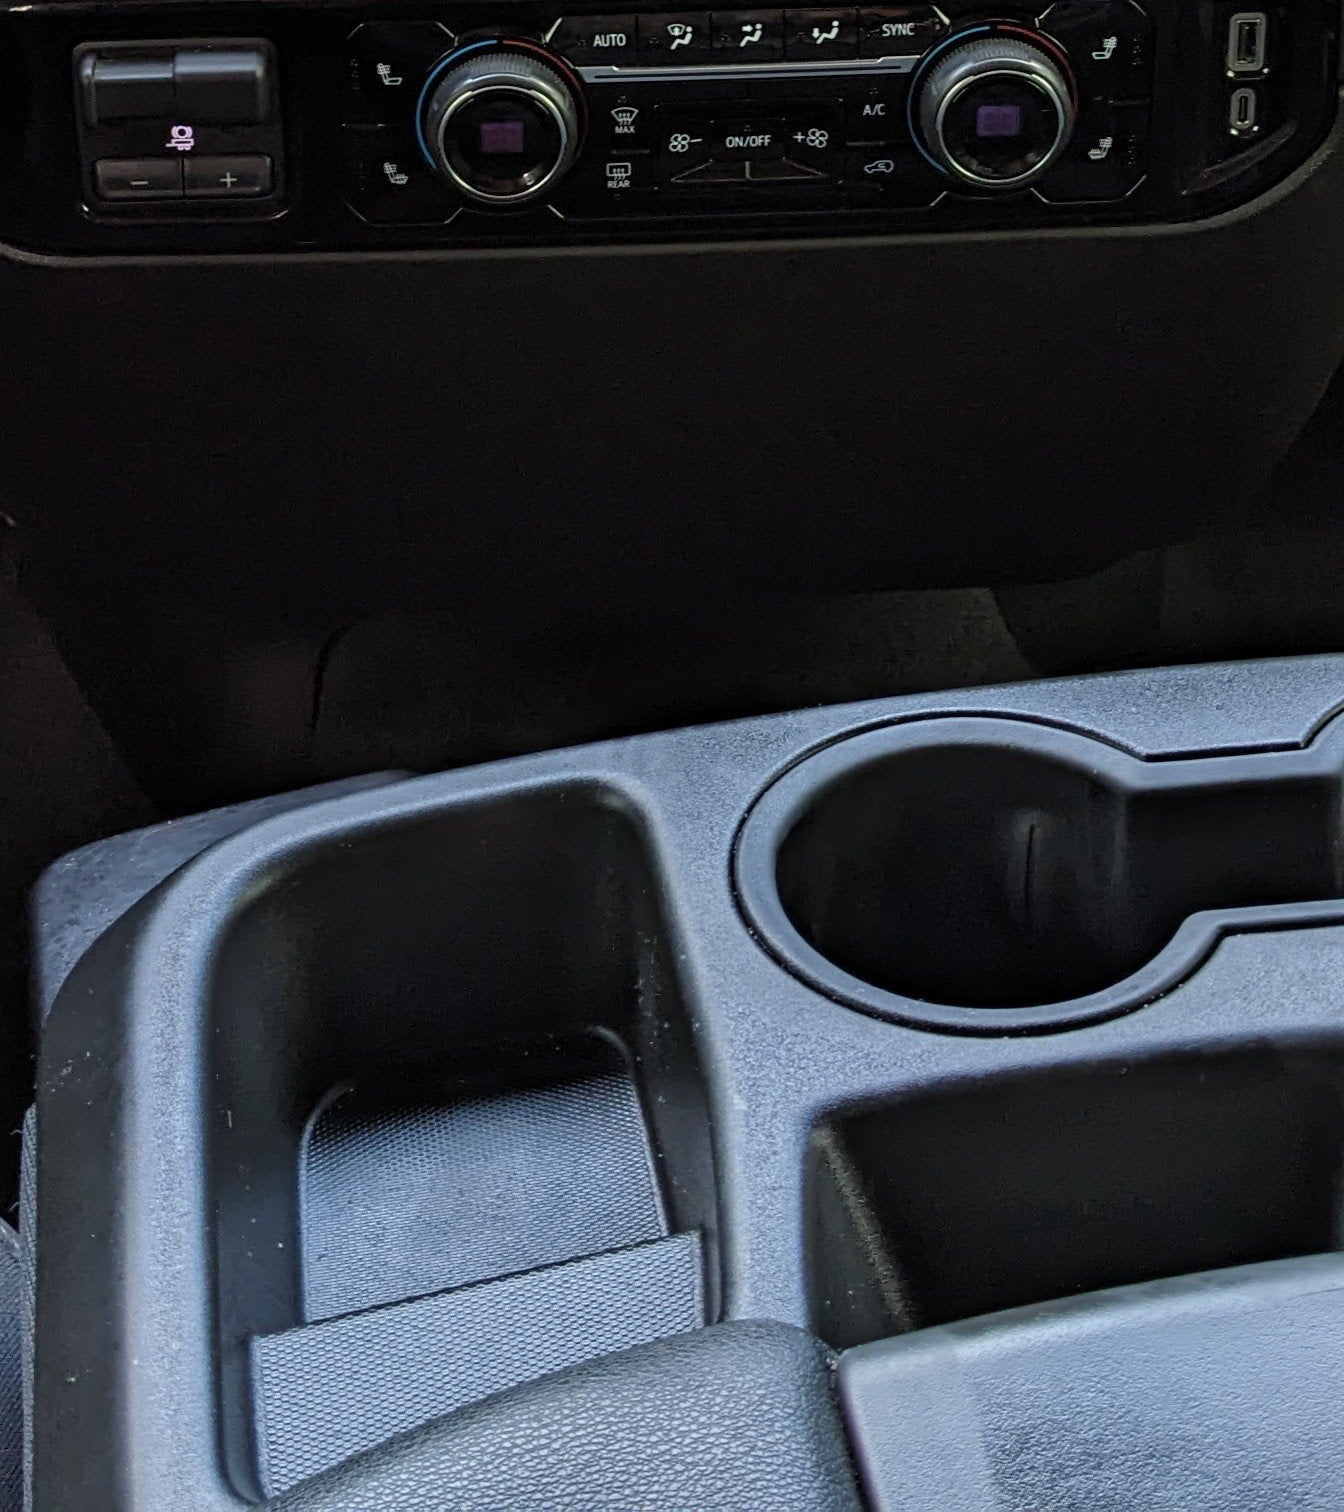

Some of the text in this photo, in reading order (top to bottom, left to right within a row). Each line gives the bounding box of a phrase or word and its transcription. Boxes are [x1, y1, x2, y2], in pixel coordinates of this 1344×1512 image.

[881, 21, 916, 37] SYNC
[593, 33, 627, 48] AUTO
[862, 103, 886, 117] A/C
[614, 124, 636, 135] MAX
[725, 134, 772, 149] ON/OFF
[607, 179, 631, 189] REAR
